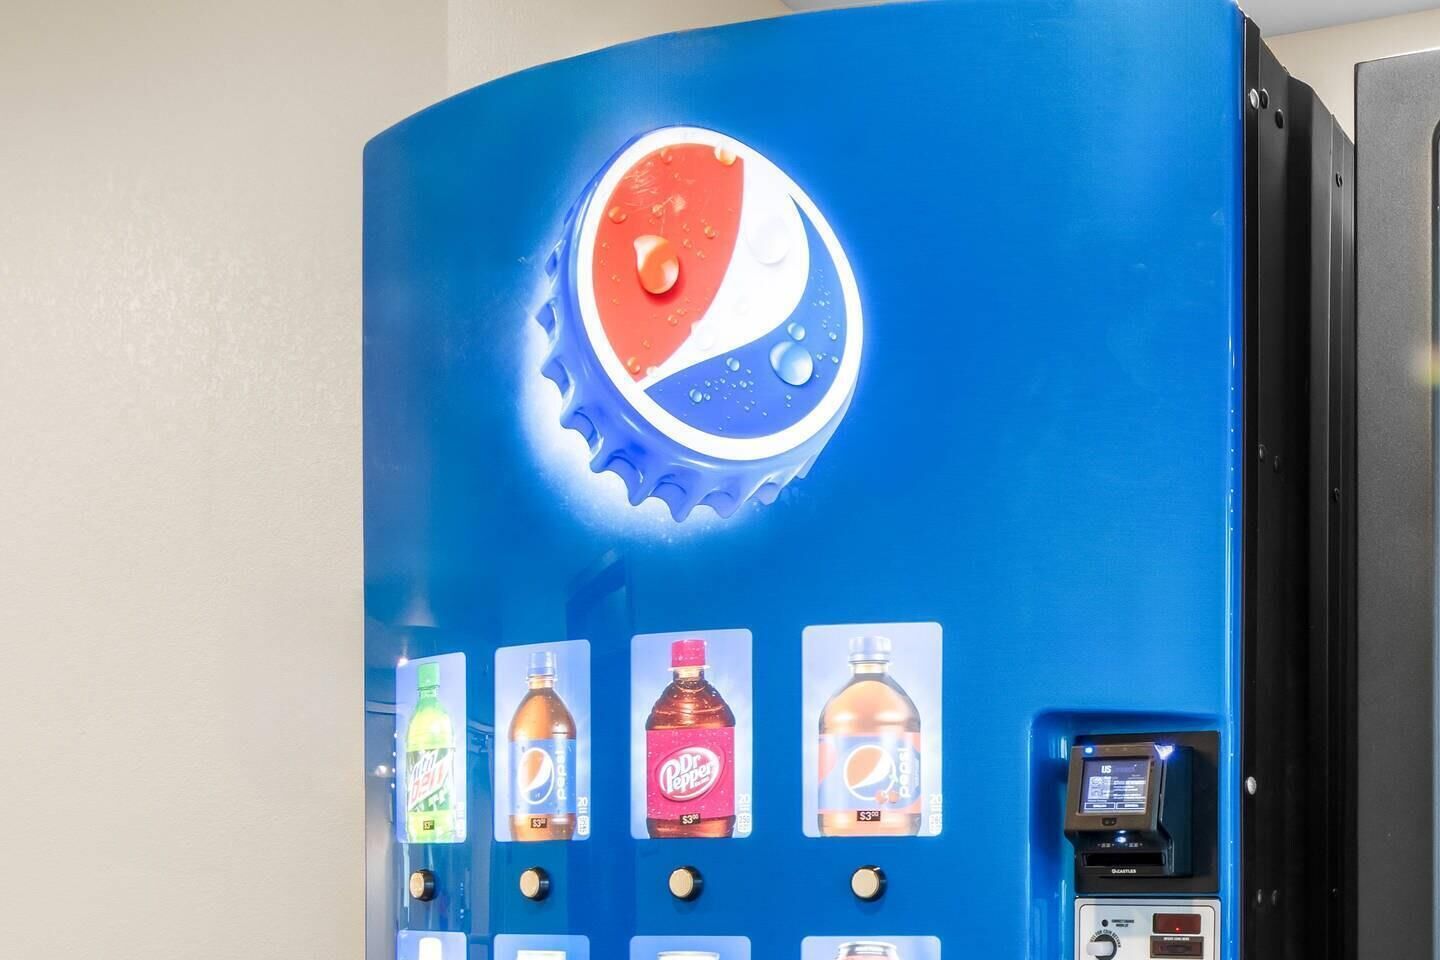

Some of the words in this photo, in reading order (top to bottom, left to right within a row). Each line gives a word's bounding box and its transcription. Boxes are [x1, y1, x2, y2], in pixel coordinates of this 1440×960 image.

[679, 752, 702, 772] Dr
[1101, 765, 1111, 773] US
[664, 759, 714, 793] Pepper
